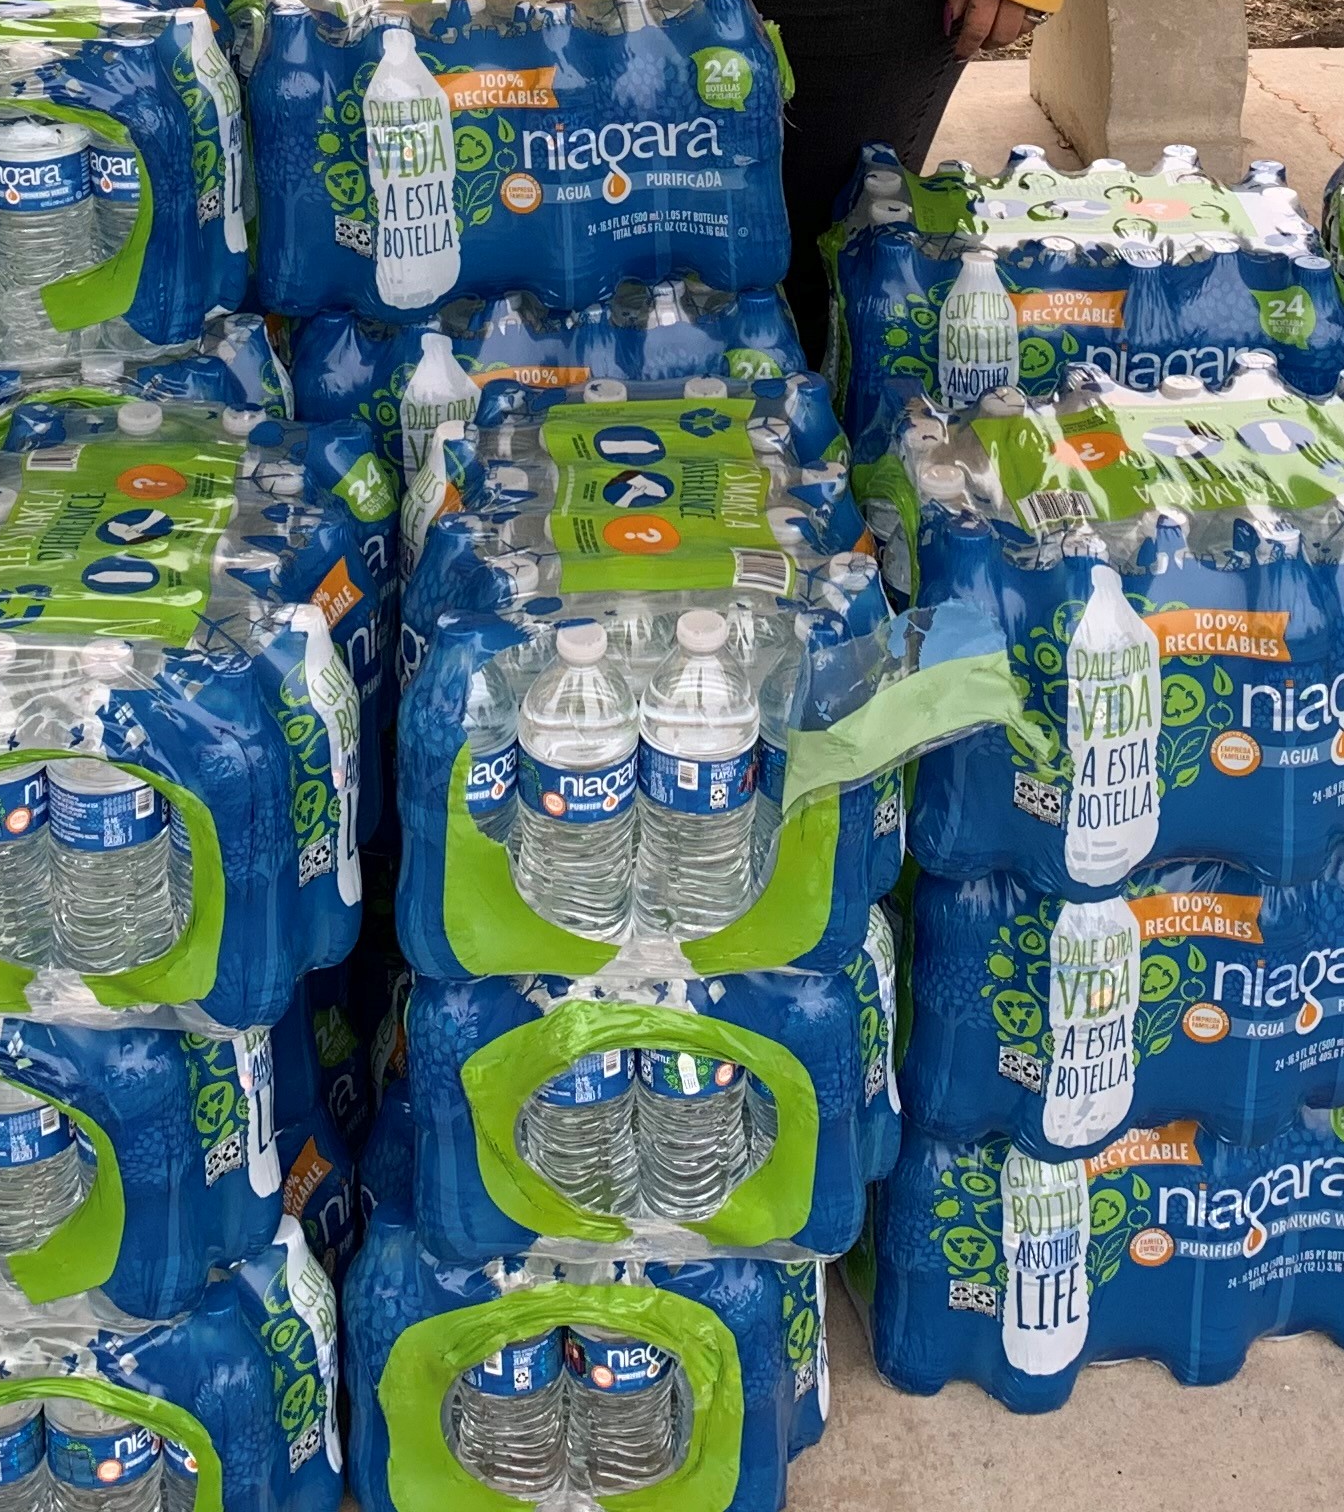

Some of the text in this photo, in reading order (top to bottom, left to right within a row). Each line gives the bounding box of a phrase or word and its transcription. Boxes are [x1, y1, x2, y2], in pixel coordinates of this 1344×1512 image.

[480, 73, 524, 87] 100%
[704, 58, 740, 83] 24
[454, 90, 548, 107] RECICLABLES
[706, 84, 740, 92] BOTELLAS
[368, 97, 442, 127] DALE OTRA
[372, 125, 446, 179] VIDA
[523, 117, 723, 204] niagara
[557, 171, 722, 200] AGUA PURIFICADA
[384, 181, 447, 221] A ESTA
[384, 219, 453, 259] BOTELLA
[946, 292, 1010, 320] GIVE THIS
[1047, 293, 1092, 306] 100%
[1268, 296, 1305, 318] 24
[1023, 307, 1116, 324] RECYCLABLE
[945, 327, 1012, 364] BOTTLE
[514, 370, 557, 384] 100%
[406, 401, 442, 431] DALE
[348, 459, 382, 506] 24
[1195, 613, 1247, 632] 100%
[1166, 633, 1279, 657] RECICLABLES
[1075, 641, 1151, 682] DALE OTRA
[1076, 675, 1152, 741] VIDA
[1081, 738, 1149, 787] A ESTA
[1279, 747, 1319, 765] AGUA
[560, 754, 638, 811] niagar
[1077, 781, 1152, 830] BOTELLA
[1313, 791, 1322, 805] 24
[1171, 896, 1223, 914] 100%
[1146, 917, 1252, 938] RECICLABLES
[1058, 927, 1133, 967] DALE OTRA
[1058, 959, 1130, 1020] VIDA
[1061, 1015, 1126, 1060] A ESTA
[1246, 1022, 1284, 1037] AGUA
[1055, 1053, 1128, 1099] BOTELLA
[1007, 1157, 1046, 1188] GIVE
[1090, 1143, 1189, 1172] RECYCLABLE
[1012, 1185, 1083, 1237] BOTTLE
[1015, 1230, 1082, 1269] ANOTHER
[1180, 1241, 1240, 1258] PURIFIED
[1271, 1212, 1331, 1235] DRINKING
[1016, 1262, 1080, 1330] LIFE
